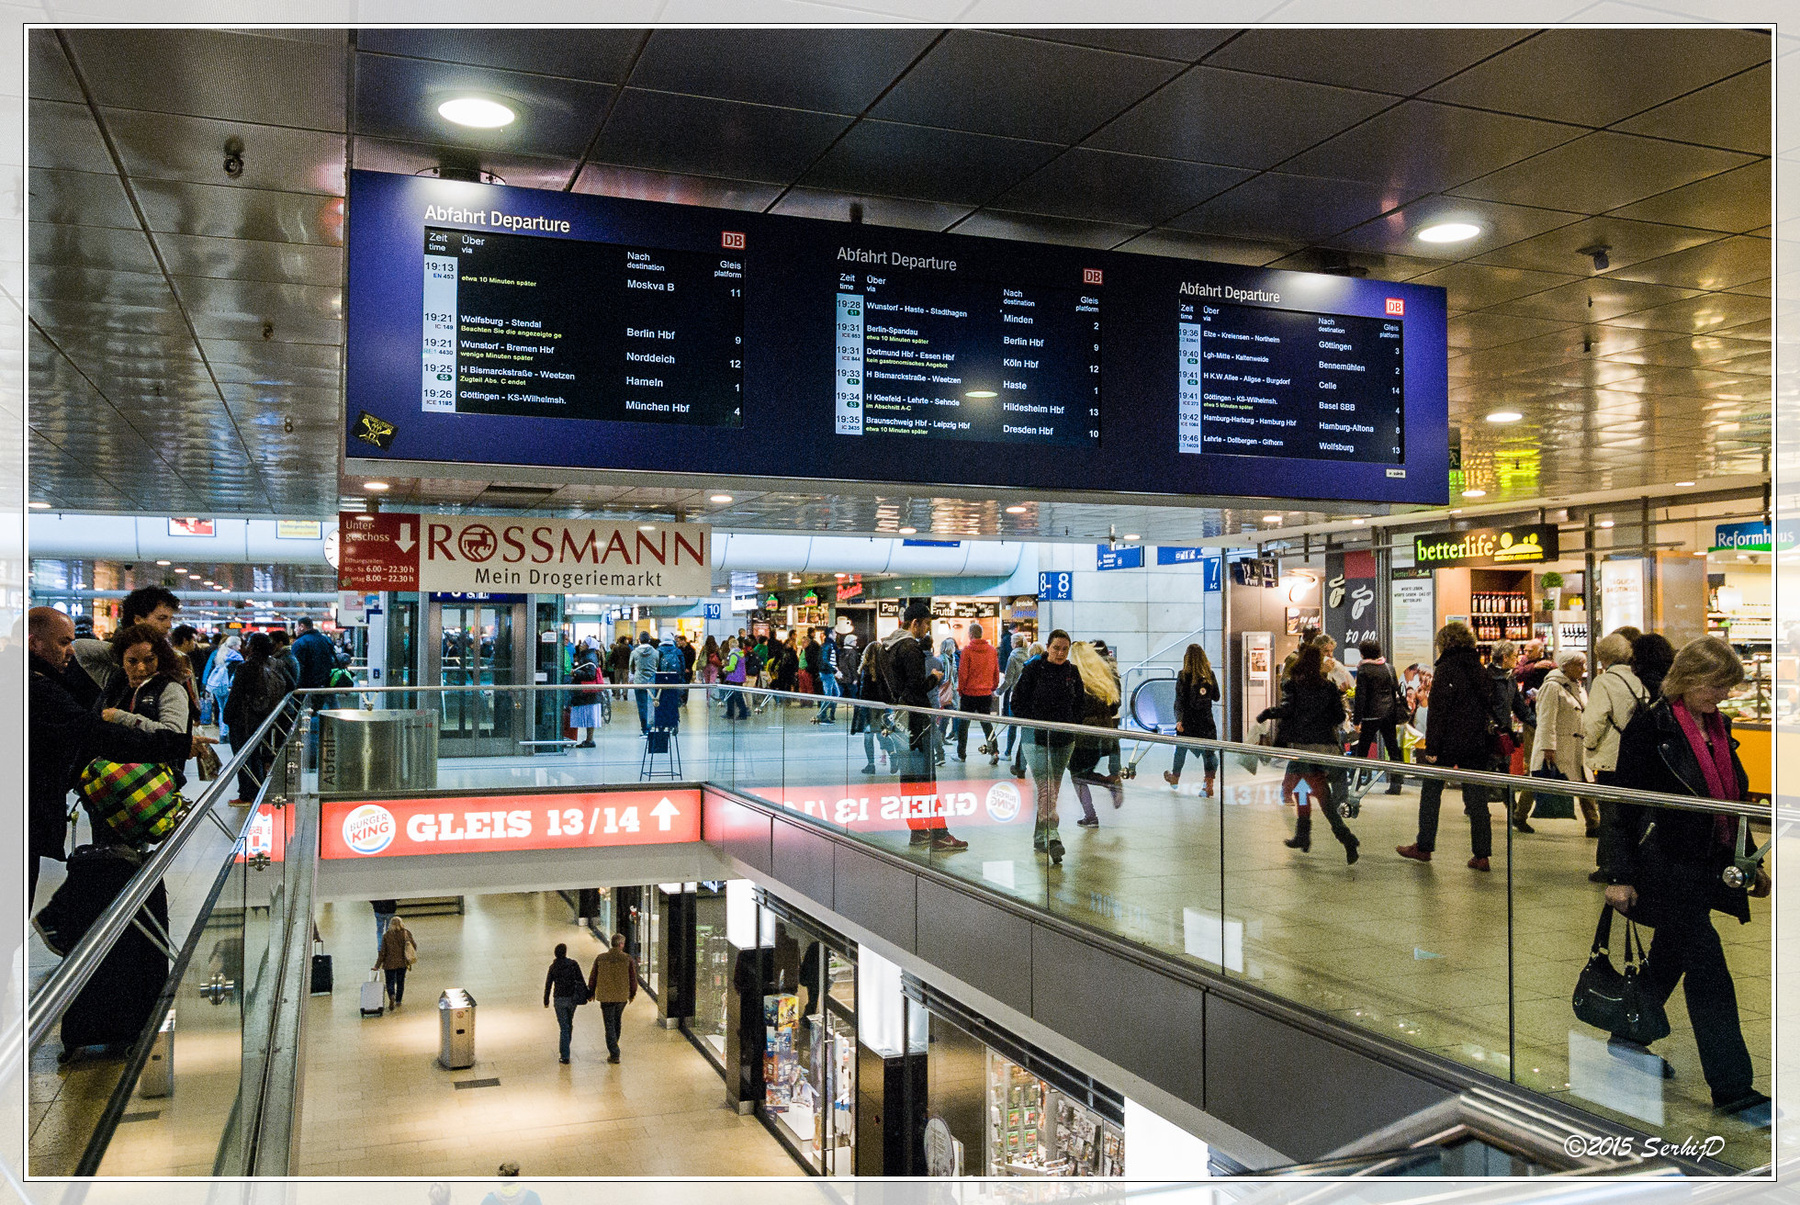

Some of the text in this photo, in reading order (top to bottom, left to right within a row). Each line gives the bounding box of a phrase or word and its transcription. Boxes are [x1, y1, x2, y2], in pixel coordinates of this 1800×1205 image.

[425, 205, 570, 233] Abfahrt Departure
[429, 233, 448, 242] Zeit
[462, 235, 485, 246] Über
[723, 233, 744, 248] DB
[429, 244, 446, 252] time
[627, 251, 650, 261] Nach
[837, 246, 957, 271] Abfahrt Departure
[425, 262, 454, 272] 19:13
[627, 262, 665, 272] destination
[720, 260, 741, 270] Gleis
[714, 270, 742, 278] platform
[840, 273, 855, 282] Zeit
[1084, 270, 1102, 283] DB
[627, 279, 675, 292] Moskva B
[730, 289, 740, 297] 11
[1004, 289, 1022, 298] Nach
[1179, 282, 1280, 302] Abfahrt Departure
[837, 300, 860, 308] 19:28
[1003, 298, 1035, 307] destination
[1080, 296, 1099, 304] Gleis
[866, 302, 967, 318] Wunstorf Haste Stadthagen
[1387, 300, 1403, 314] DB
[425, 313, 452, 322] 19:21
[461, 315, 541, 328] Wolfsburg Stendal
[1004, 314, 1034, 324] Minden
[837, 323, 860, 331] 19:31
[866, 325, 918, 336] Berlin-Spandau
[1094, 322, 1099, 330] 2
[626, 328, 675, 339] Berlin Hbf
[424, 338, 452, 347] 19:21
[735, 336, 742, 345] 9
[1004, 336, 1044, 347] Berlin Hbf
[461, 340, 554, 354] Wunstorf Bremen Hbf
[837, 346, 859, 354] 19:31
[1319, 341, 1352, 351] Göttingen
[513, 353, 533, 362] später
[866, 348, 899, 357] Dortmund
[626, 352, 675, 364] Norddeich
[1004, 358, 1039, 368] Köln Hbf
[424, 364, 453, 373] 19:25
[730, 360, 741, 368] 12
[1089, 365, 1099, 373] 12
[1319, 361, 1365, 372] Bennemühlen
[470, 366, 532, 378] Bismarckstraße
[540, 370, 575, 380] Weetzen
[837, 369, 860, 378] 19:33
[874, 371, 926, 382] Bismarckstraße
[932, 375, 961, 384] Weetzen
[460, 376, 482, 384] Zugteil
[626, 376, 663, 387] Hameln
[1319, 381, 1337, 389] Celle
[735, 384, 740, 392] 1
[1004, 381, 1027, 390] Haste
[424, 390, 452, 398] 19:26
[460, 390, 566, 404] Göttingen KS-Wilhelmsh.
[837, 392, 860, 400] 19:34
[626, 400, 690, 413] München Hbf
[1003, 403, 1064, 414] Hildesheim Hbf
[1319, 402, 1355, 411] Basel SBB
[734, 408, 740, 416] 4
[837, 415, 860, 423] 19:35
[866, 417, 913, 426] Braunschweig
[933, 421, 956, 430] Leipzig
[1003, 425, 1054, 435] Dresden Hbf
[1319, 422, 1374, 432] Hamburg-Altona
[1319, 443, 1354, 453] Wolfsburg
[346, 520, 375, 529] Unter-
[346, 532, 390, 543] geschoss
[428, 523, 704, 566] ROSSMANN
[1416, 534, 1494, 561] betterlife
[1211, 558, 1220, 581] 7
[475, 568, 662, 588] Mein Drogeriemarkt
[1040, 573, 1046, 592] 8
[1058, 573, 1070, 592] 8
[709, 605, 719, 615] 10
[882, 603, 898, 612] Pan
[931, 608, 955, 616] Frutta
[1346, 629, 1359, 643] to
[350, 814, 388, 832] BURGER
[406, 807, 640, 842] GLEIS 13/14
[352, 822, 389, 843] KING
